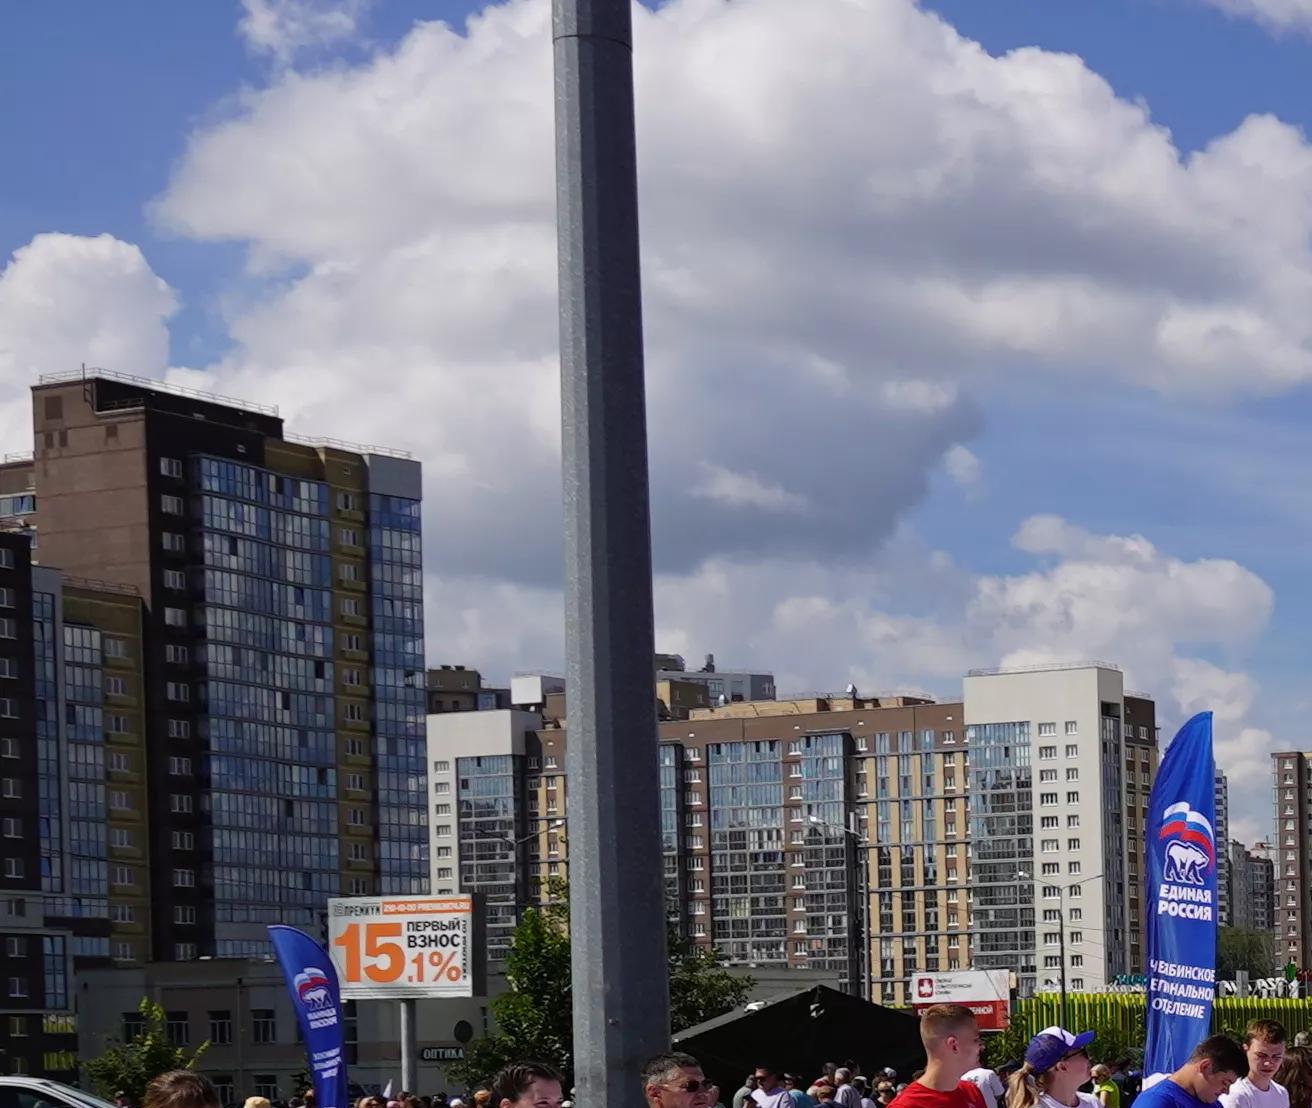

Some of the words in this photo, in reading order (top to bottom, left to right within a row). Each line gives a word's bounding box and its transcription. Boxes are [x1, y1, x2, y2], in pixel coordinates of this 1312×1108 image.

[1159, 884, 1212, 904] ЕДИНАЯ
[1158, 900, 1212, 921] РОССИЯ
[407, 917, 461, 932] ПЕРВЫЙ
[407, 934, 461, 948] ВЗНОС
[423, 1048, 465, 1060] ОПТИКА
